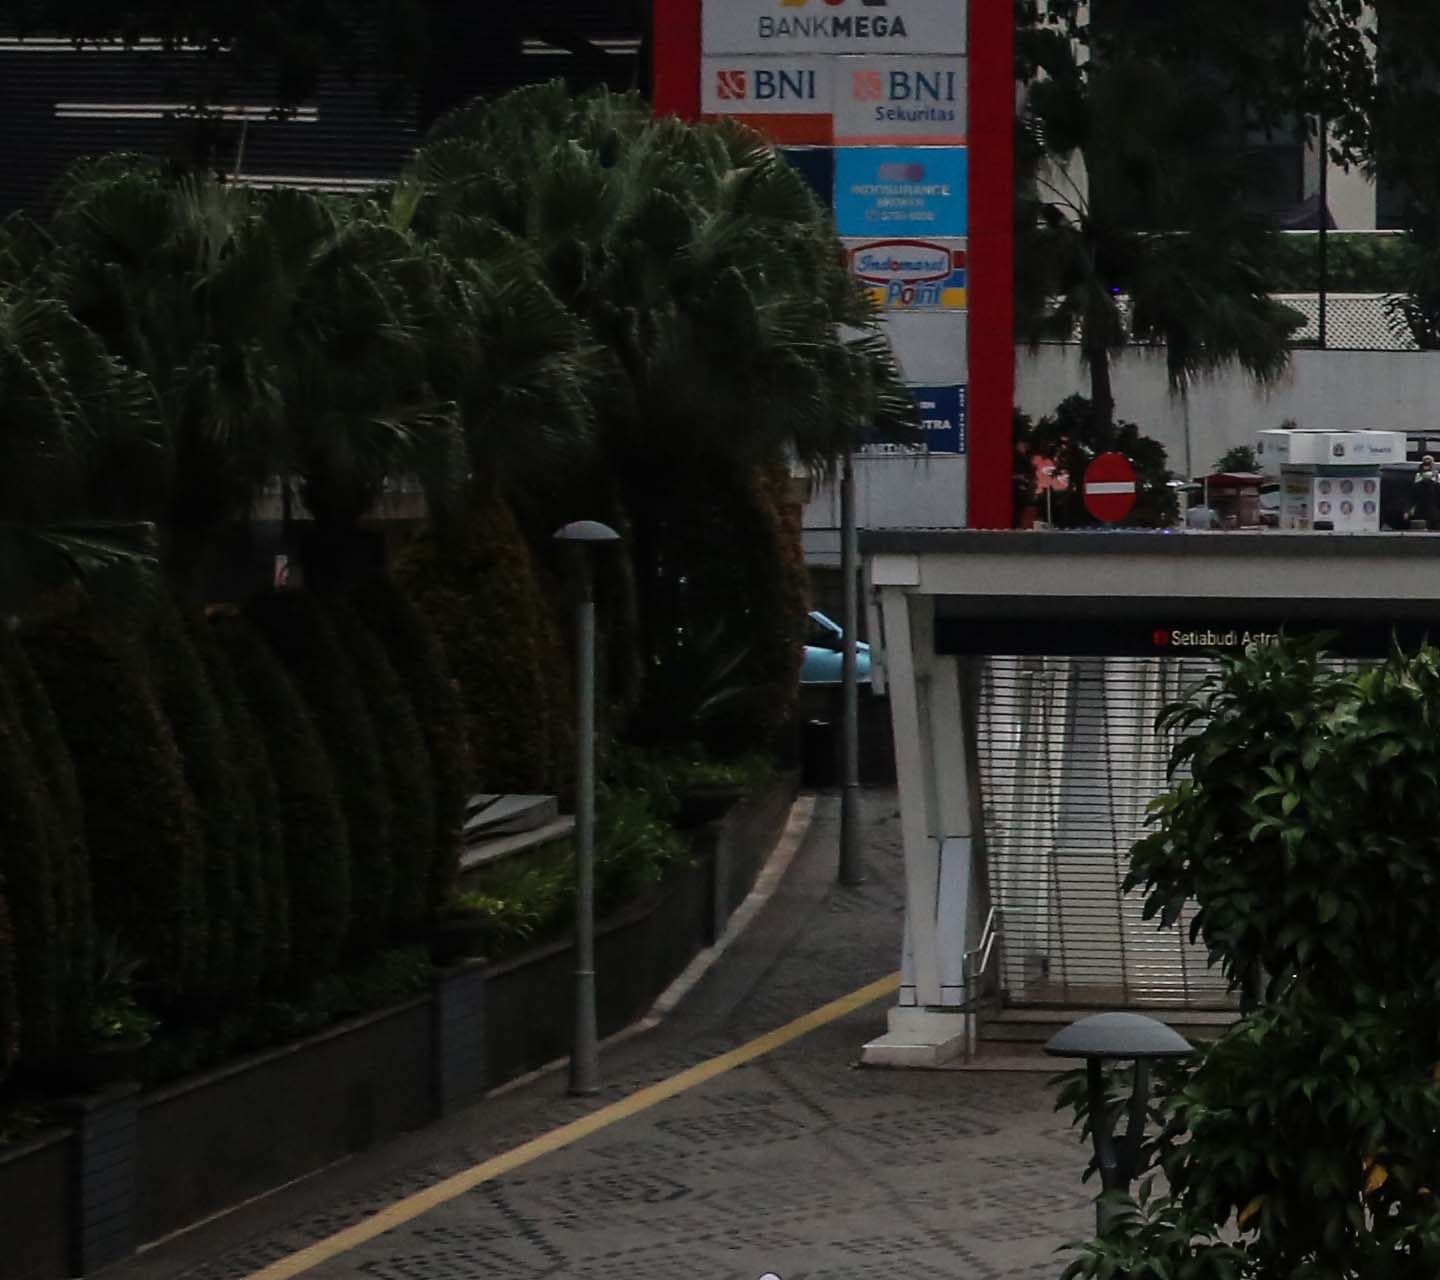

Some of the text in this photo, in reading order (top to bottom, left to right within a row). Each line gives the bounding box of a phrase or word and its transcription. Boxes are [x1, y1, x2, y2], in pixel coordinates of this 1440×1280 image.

[755, 70, 816, 99] BNI
[888, 71, 955, 101] BNI
[875, 106, 955, 121] Sekuritas
[887, 279, 942, 305] Point
[1171, 629, 1238, 646] Setiabudi
